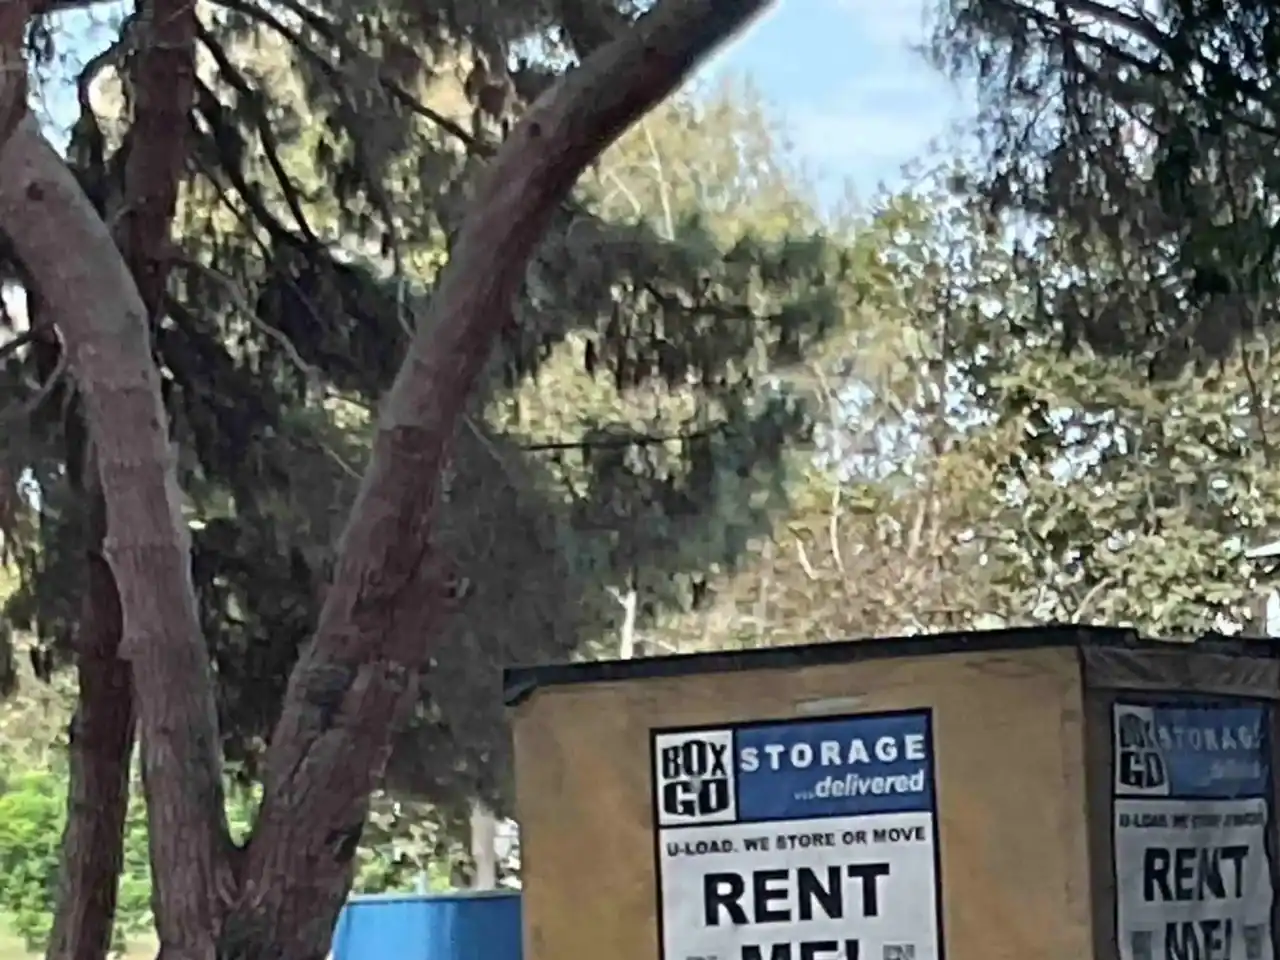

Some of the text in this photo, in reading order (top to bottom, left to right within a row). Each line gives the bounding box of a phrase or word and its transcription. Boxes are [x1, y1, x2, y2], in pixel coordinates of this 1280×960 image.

[661, 739, 728, 780] BOX
[740, 734, 926, 772] STORAGE
[663, 776, 730, 818] GO
[744, 836, 770, 852] WE
[776, 832, 836, 851] STORE
[842, 829, 869, 847] OR
[873, 826, 926, 844] MOVE
[1143, 845, 1249, 902] RENT
[703, 862, 890, 927] RENT
